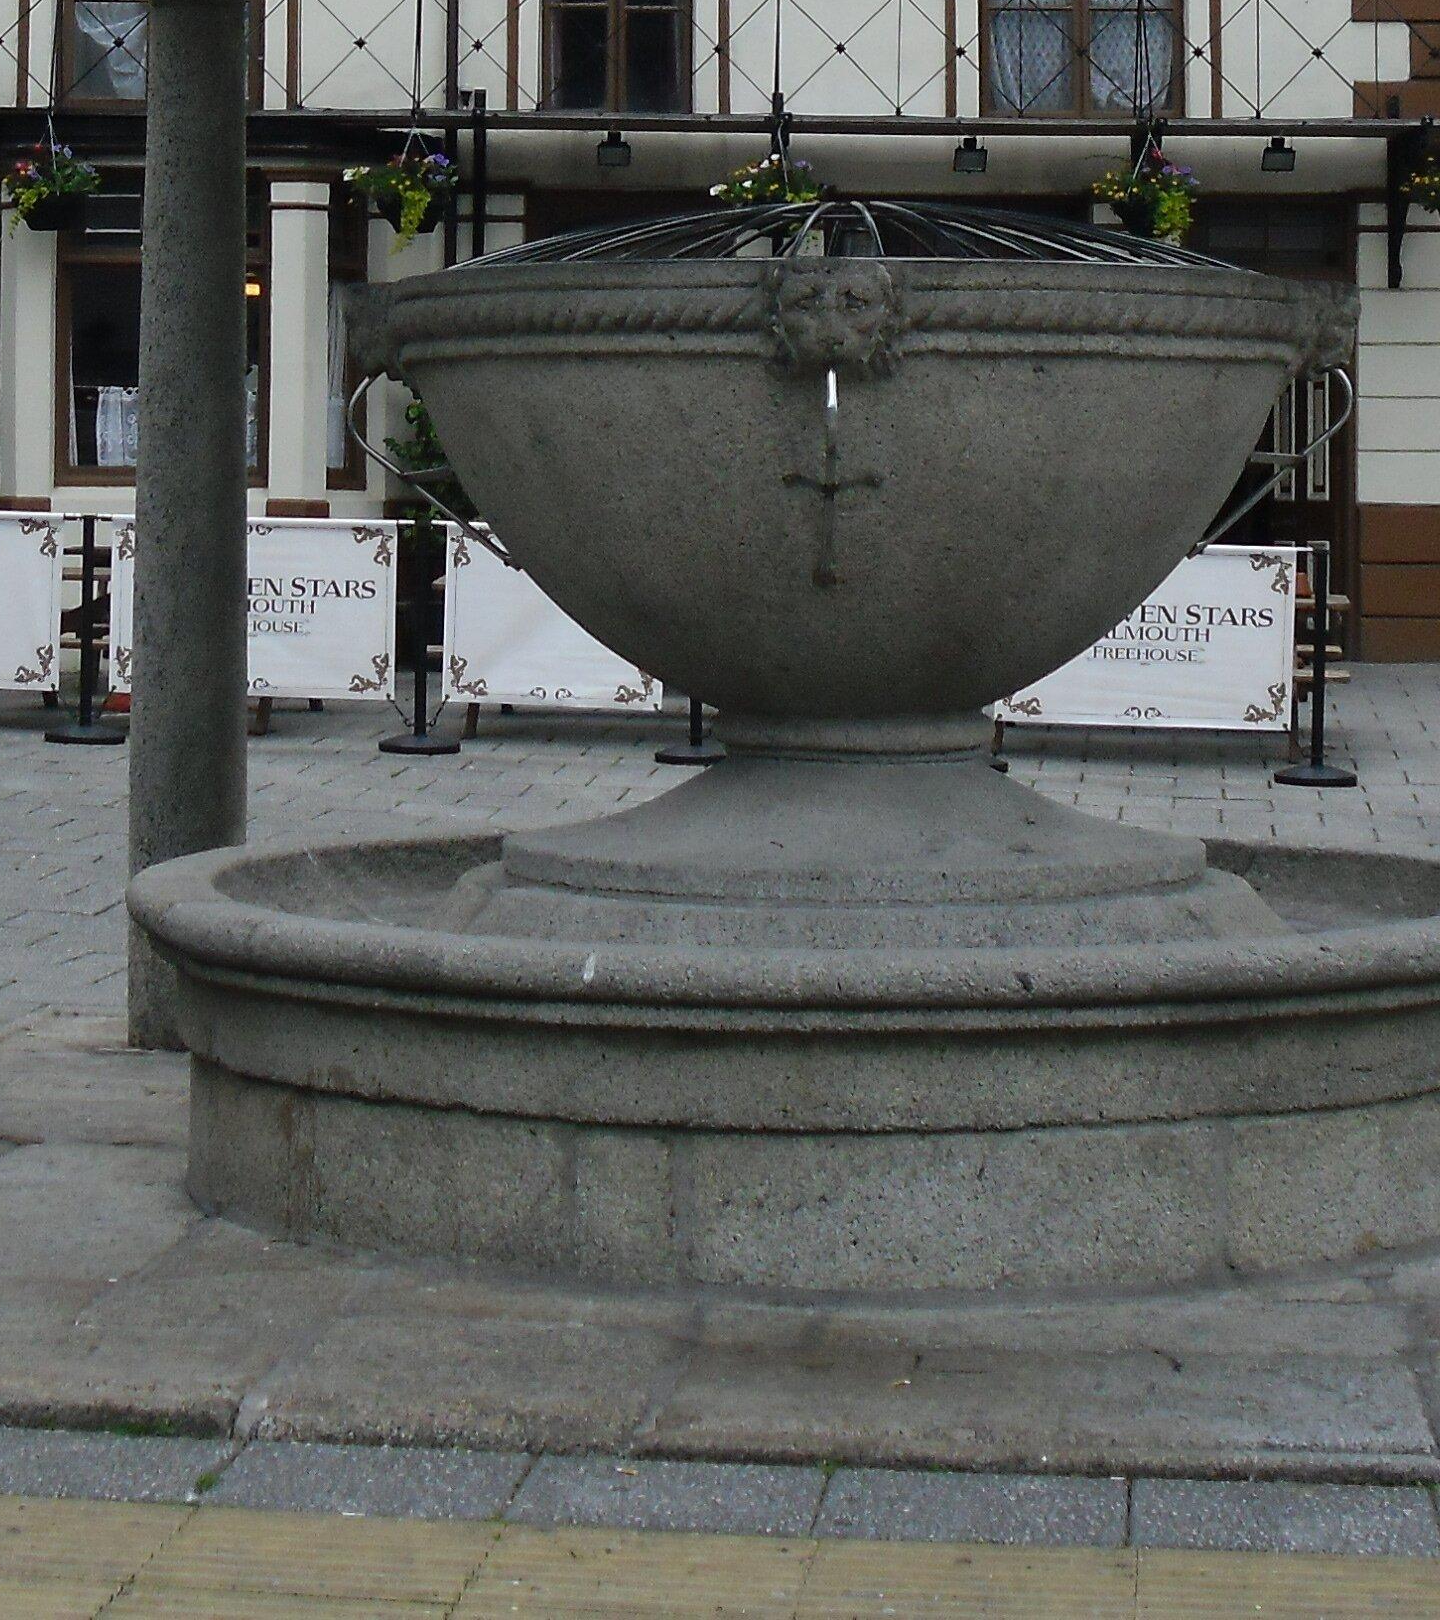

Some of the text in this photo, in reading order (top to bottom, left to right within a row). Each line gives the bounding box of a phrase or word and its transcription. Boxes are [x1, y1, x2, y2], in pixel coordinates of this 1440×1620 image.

[248, 577, 377, 600] EN STARS
[1185, 603, 1274, 629] STARS
[1092, 644, 1200, 663] FREEHOUSE
